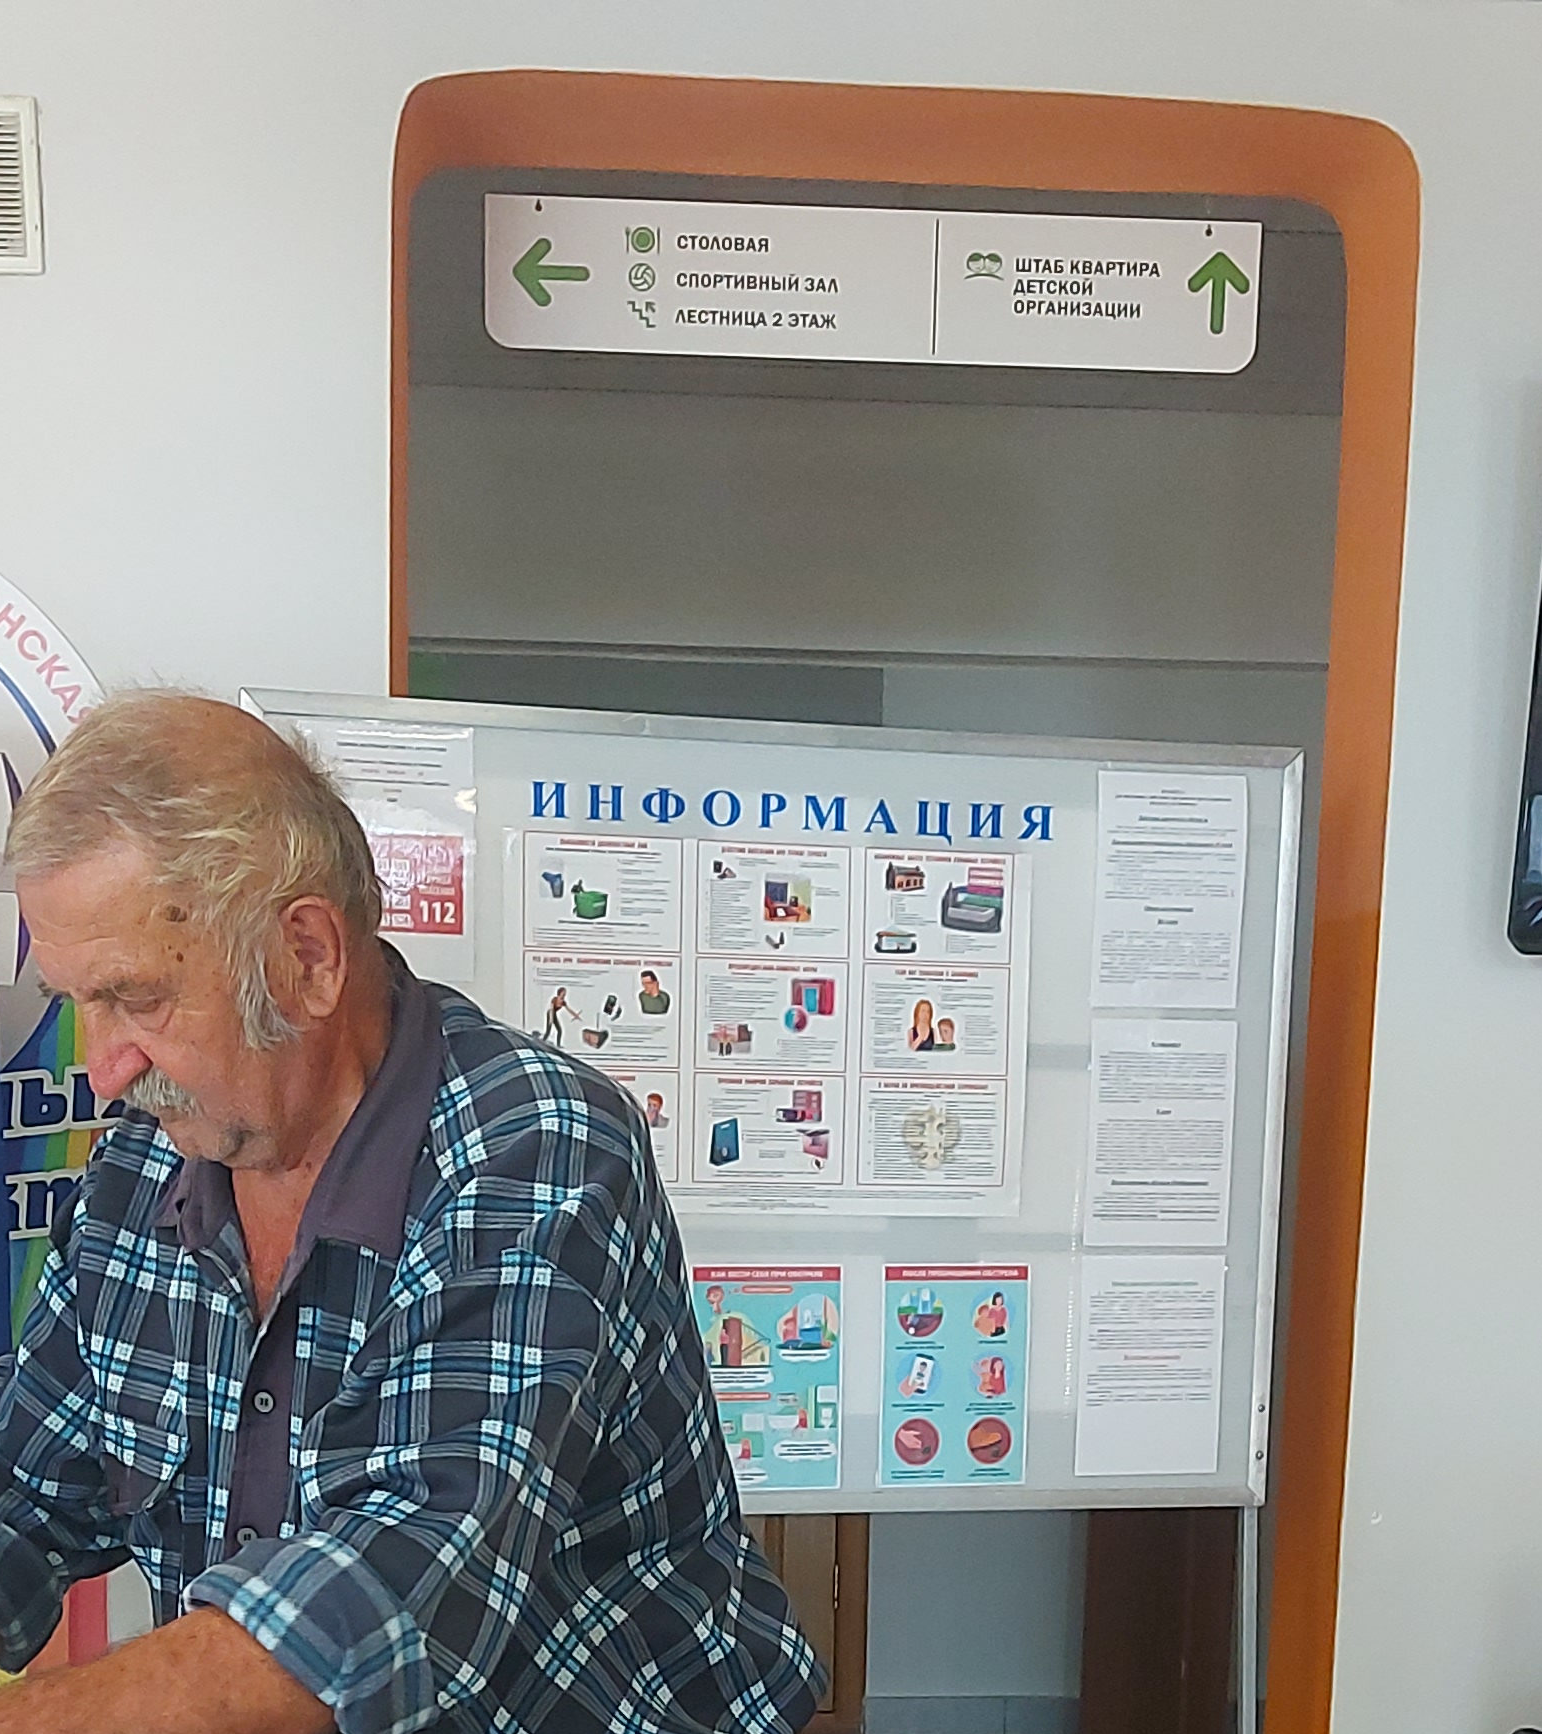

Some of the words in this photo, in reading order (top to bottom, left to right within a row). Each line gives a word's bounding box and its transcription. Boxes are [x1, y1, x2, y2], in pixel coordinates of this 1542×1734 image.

[677, 235, 769, 252] СТОЛОВАЯ
[1015, 258, 1064, 273] ШТАБ
[1070, 260, 1160, 277] КВАРТИРА
[676, 272, 799, 292] СПОРТИВНЫЙ
[804, 277, 838, 293] ЗАЛ
[1013, 278, 1093, 296] ДЕТСКОЙ
[675, 309, 767, 328] ЛЕСТНИЦА
[772, 312, 783, 327] 2
[788, 313, 837, 329] ЭТАЖ
[1014, 300, 1140, 320] ОРГАНИЗАЦИИ
[529, 781, 1054, 846] ИНФОРМАЦИЯ
[420, 900, 455, 923] 112
